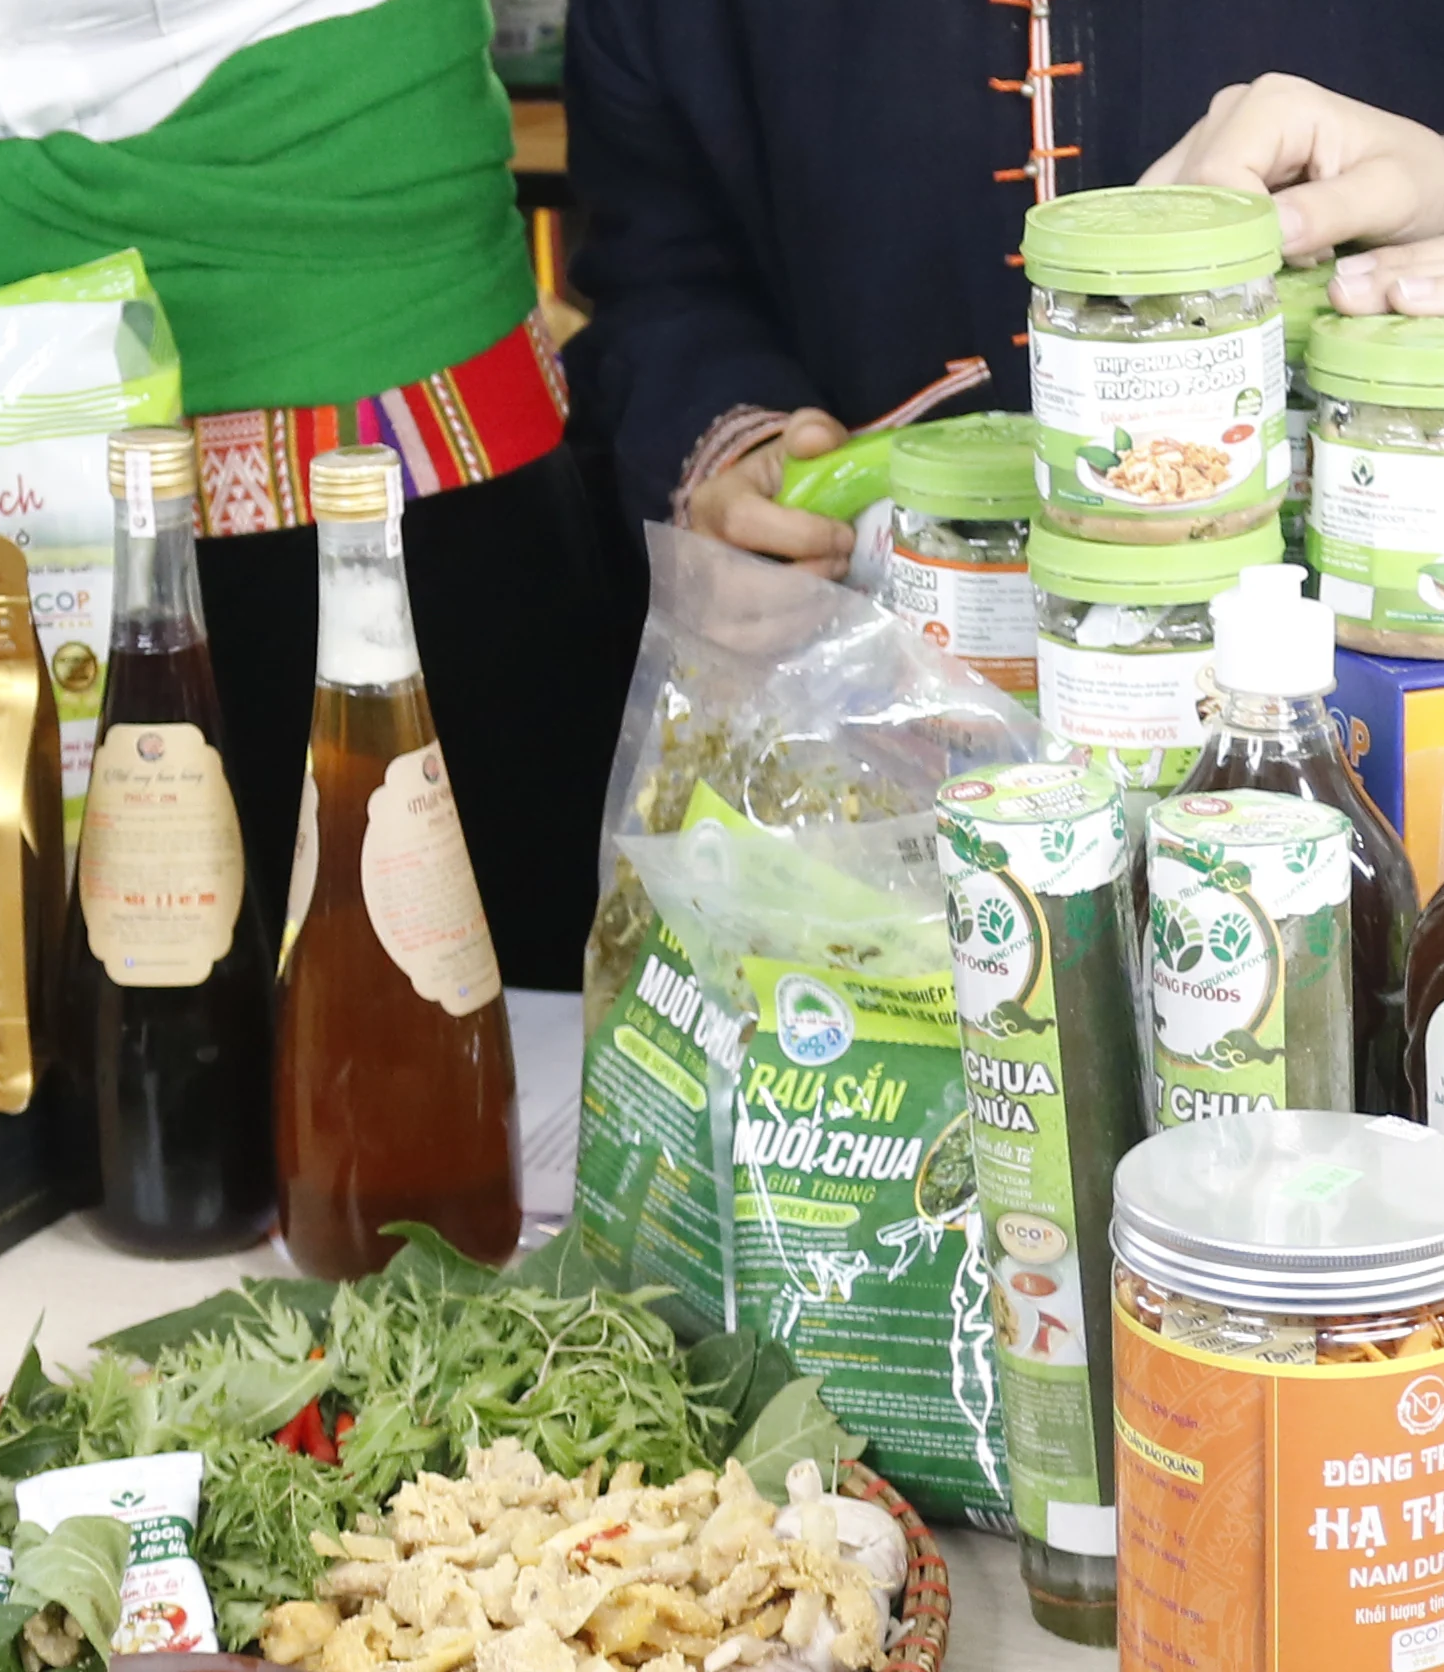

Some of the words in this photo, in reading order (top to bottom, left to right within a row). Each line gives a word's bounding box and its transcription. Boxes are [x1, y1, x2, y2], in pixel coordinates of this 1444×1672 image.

[1094, 356, 1128, 376] THỊT
[1130, 354, 1183, 373] CHUA
[1185, 338, 1243, 373] SẠCH
[1095, 376, 1179, 400] TRƯỜNG
[1183, 366, 1245, 396] FOODS
[34, 591, 90, 613] COP
[1141, 726, 1178, 741] 100%
[1182, 982, 1241, 1004] FOODS
[964, 1050, 1057, 1096] CHUA
[744, 1062, 827, 1113] RAU
[826, 1061, 908, 1123] SẮN
[975, 1094, 1037, 1134] NỨA
[821, 1131, 923, 1181] CHUA
[810, 1179, 877, 1203] TRANG
[1004, 1222, 1053, 1246] OCOP
[1322, 1452, 1413, 1487] ĐÔNG
[1307, 1505, 1387, 1558] HẠ
[1348, 1561, 1408, 1589] NAM
[1355, 1604, 1387, 1625] Khối
[1390, 1600, 1427, 1622] lượng
